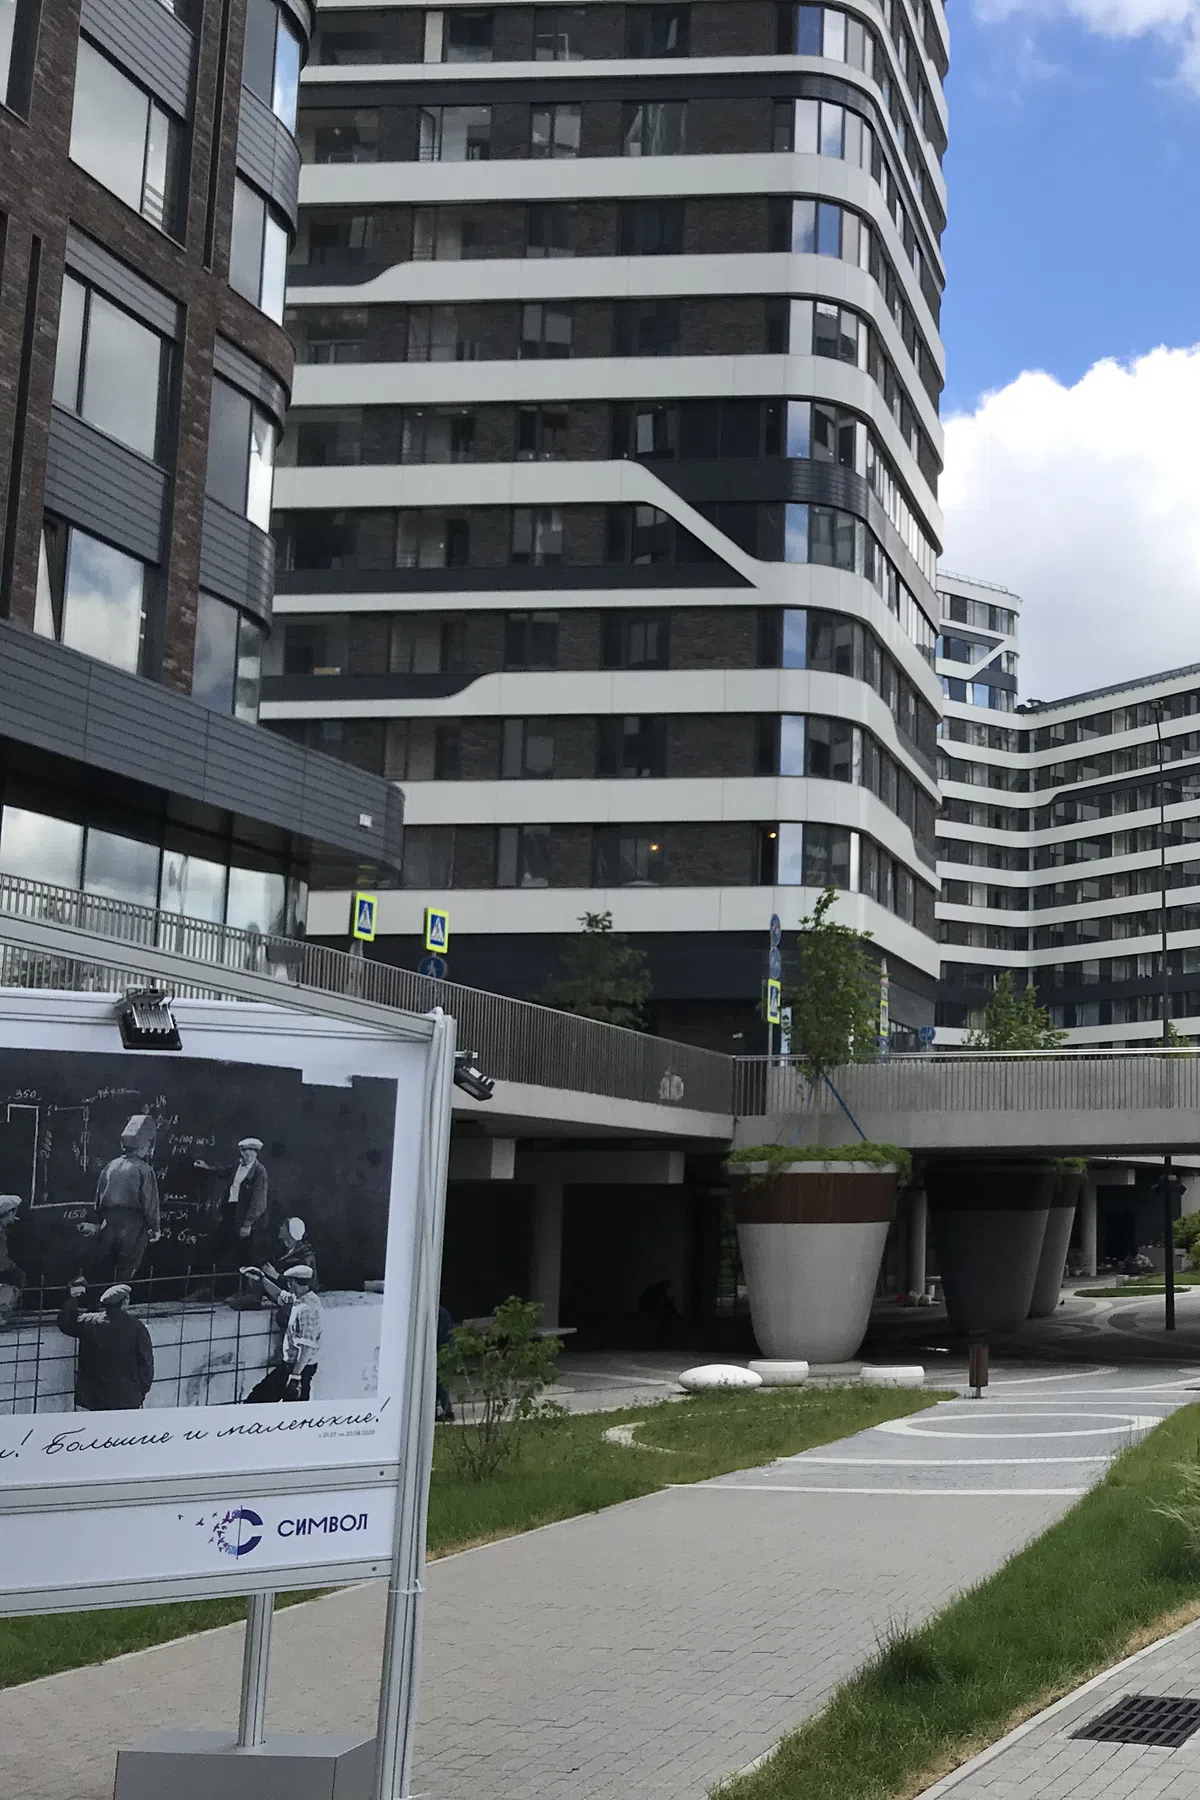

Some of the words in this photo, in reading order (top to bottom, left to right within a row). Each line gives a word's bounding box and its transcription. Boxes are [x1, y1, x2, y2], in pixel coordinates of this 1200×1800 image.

[41, 1427, 175, 1455] Большие
[182, 1429, 209, 1441] и
[216, 1397, 391, 1437] маленькие!
[276, 1513, 368, 1538] СИМВОЛ
